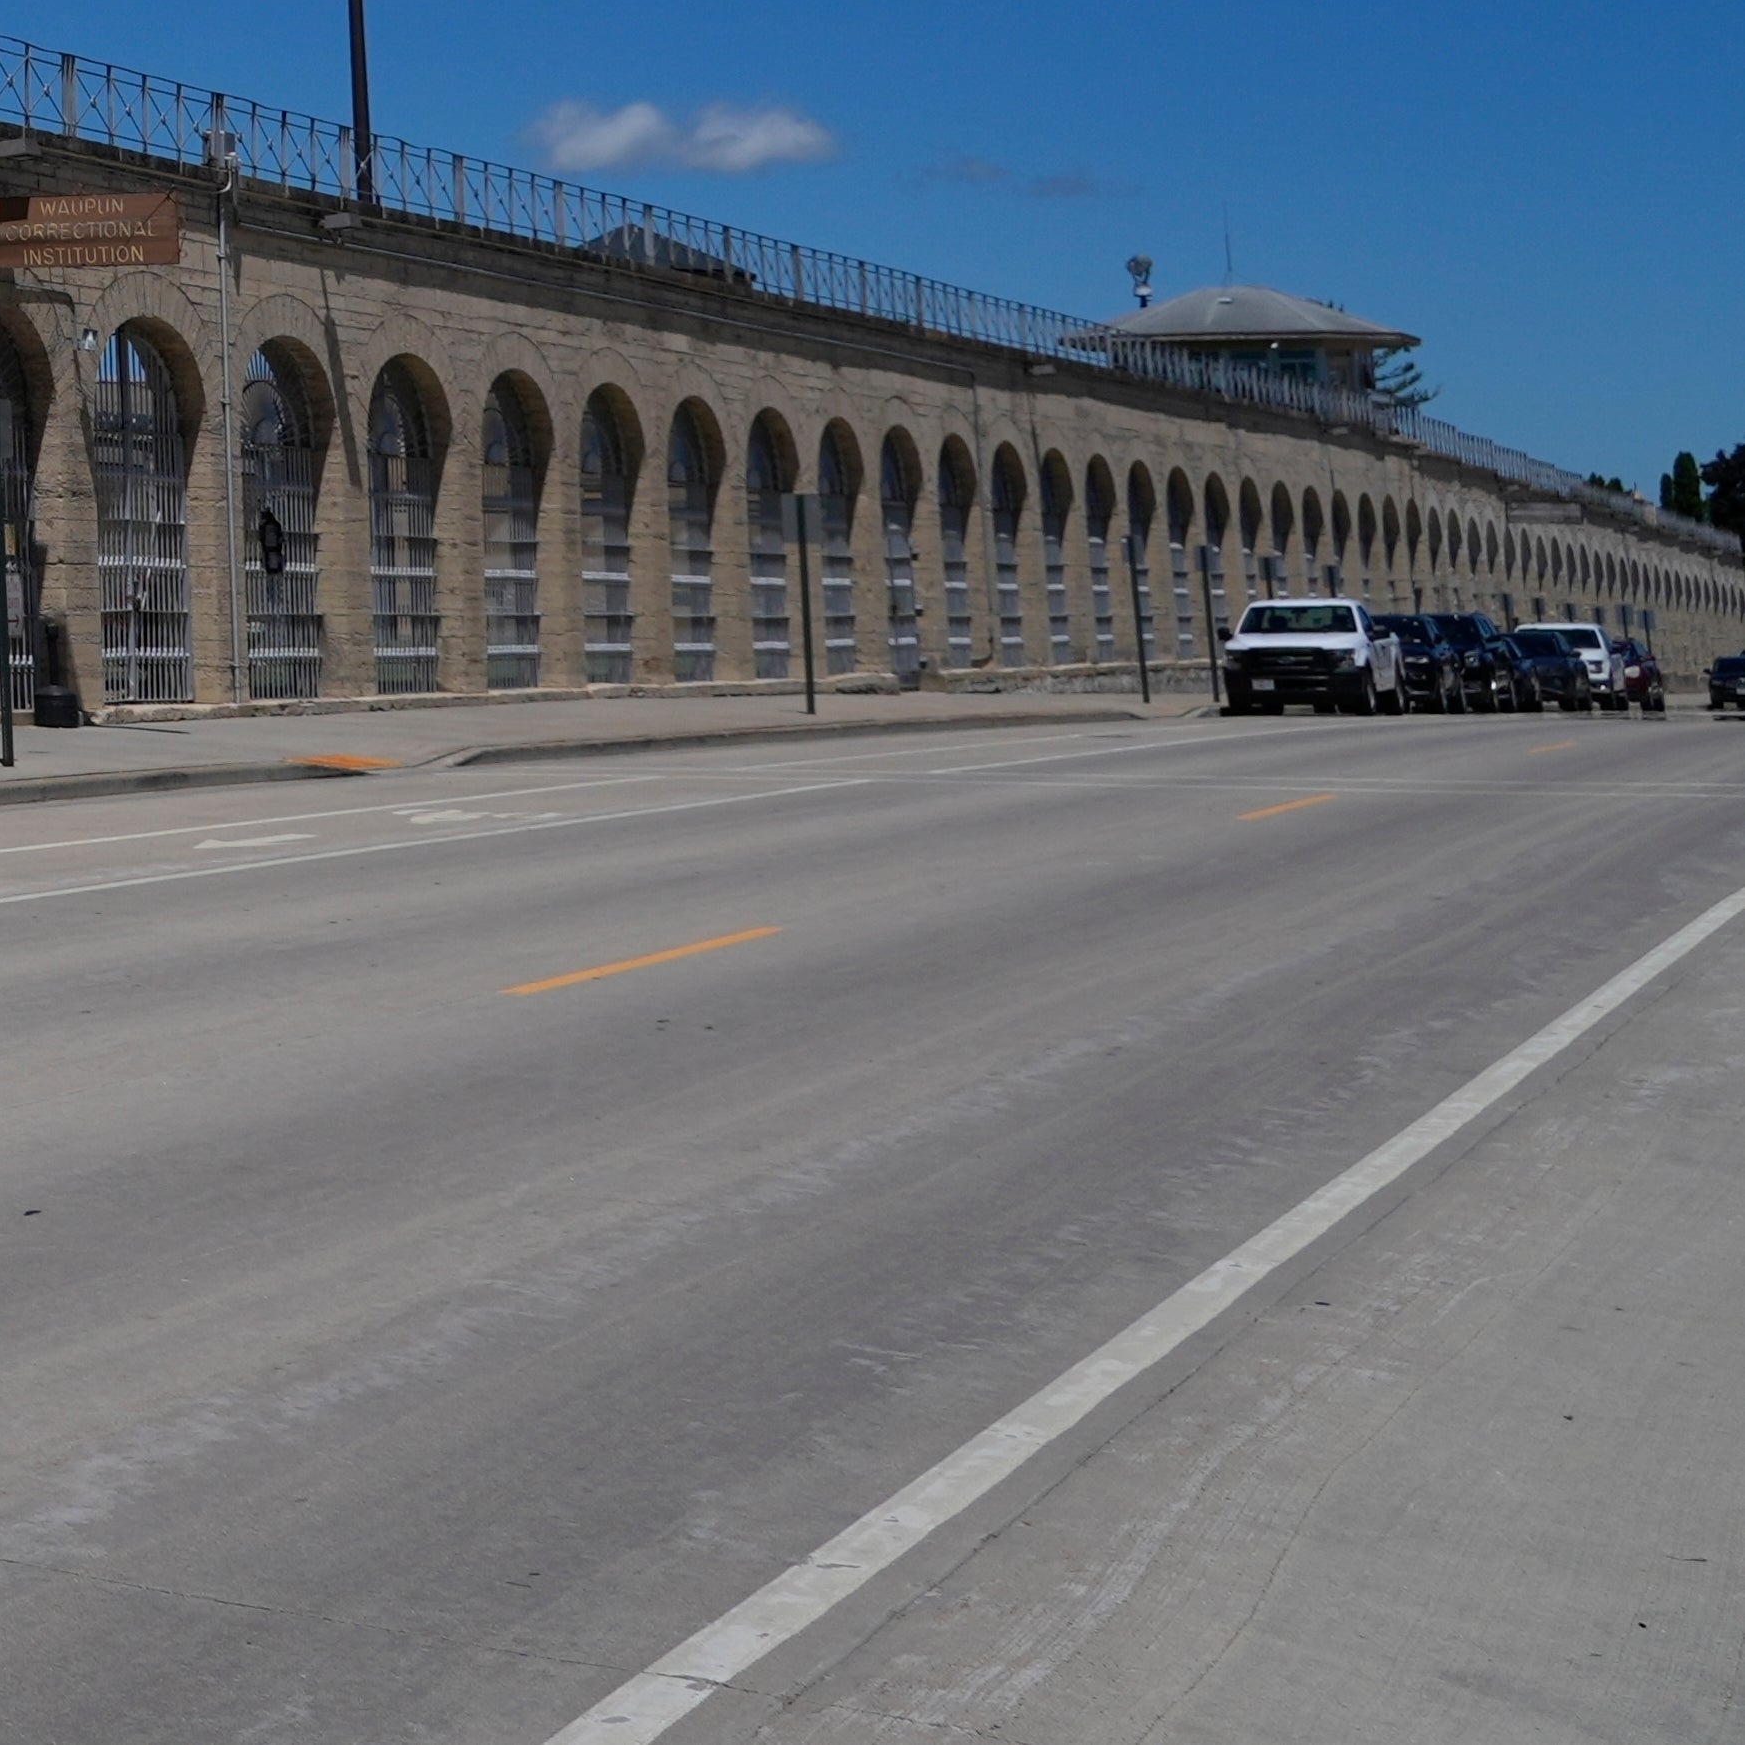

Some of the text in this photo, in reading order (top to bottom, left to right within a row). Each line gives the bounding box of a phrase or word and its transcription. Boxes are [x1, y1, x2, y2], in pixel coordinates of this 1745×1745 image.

[40, 198, 124, 216] WAUPUN
[5, 218, 160, 241] CORRECTIONAL
[23, 245, 144, 266] INSTITUTION
